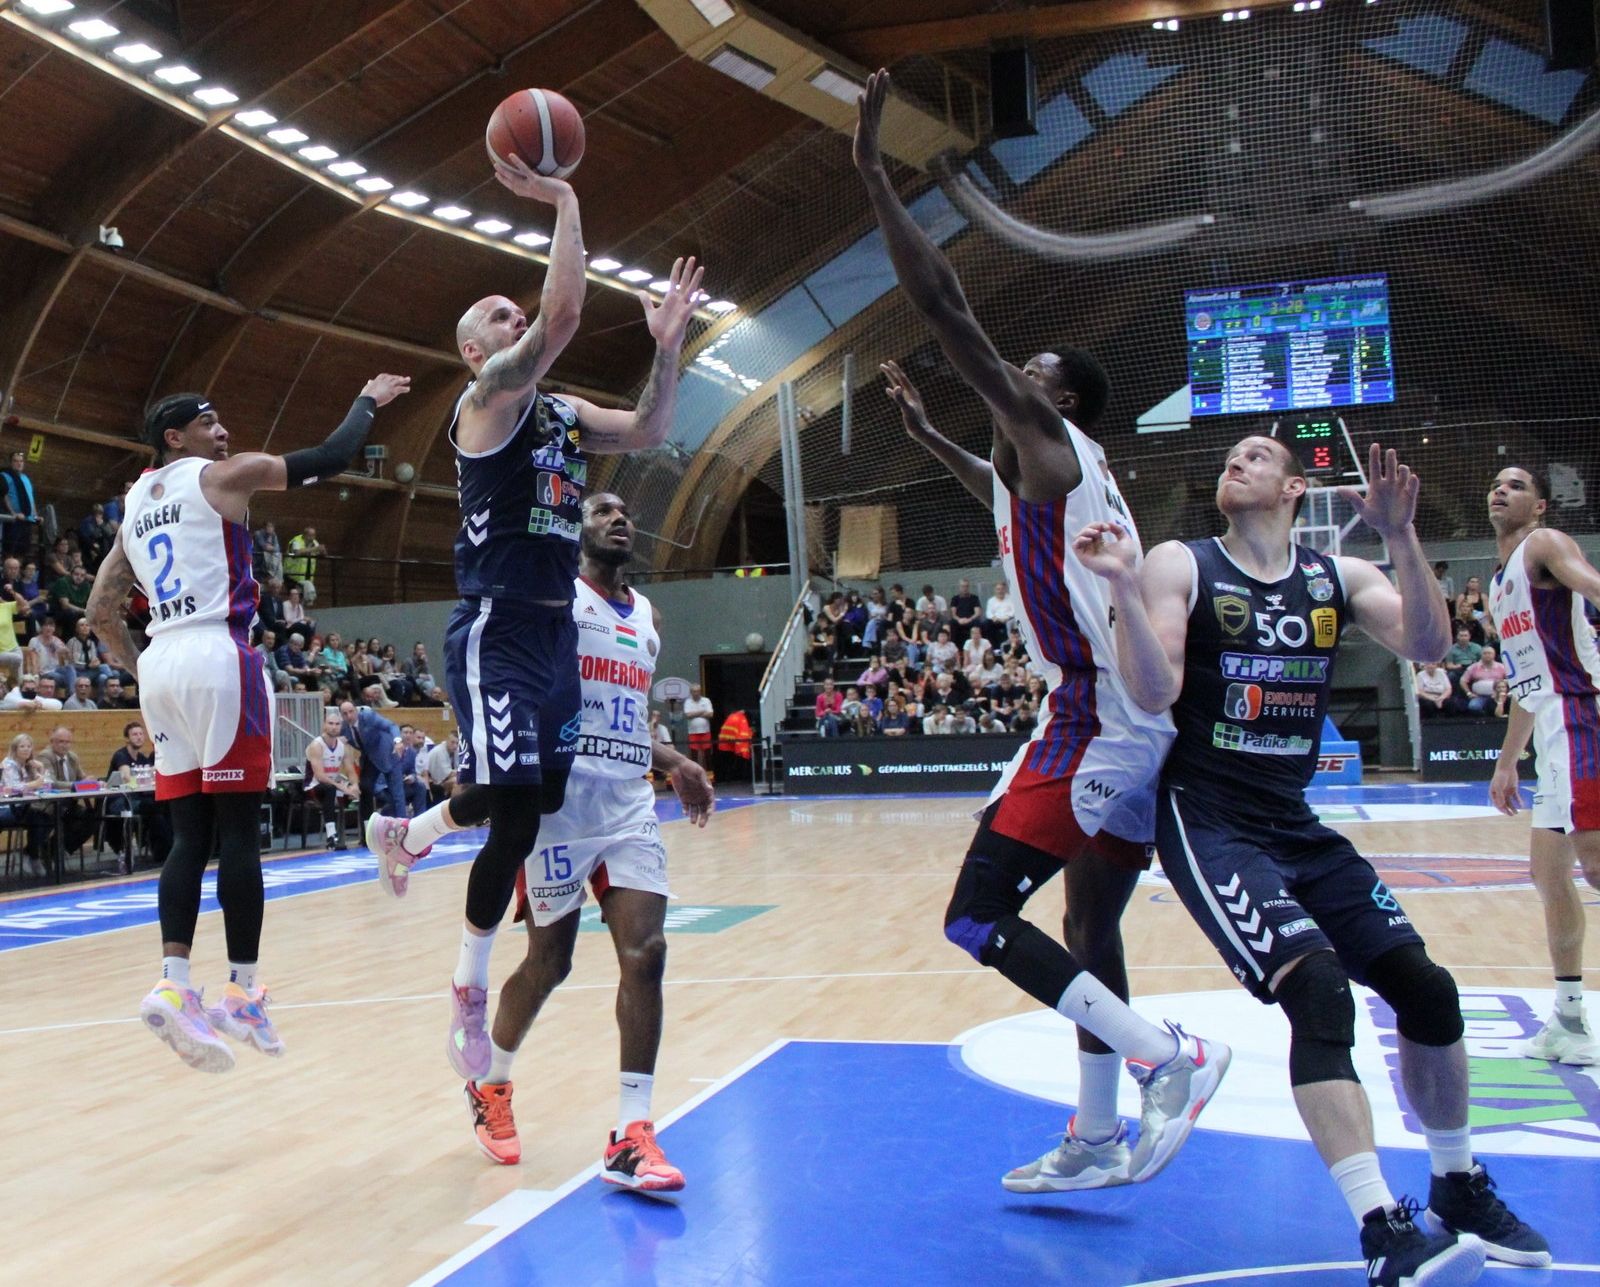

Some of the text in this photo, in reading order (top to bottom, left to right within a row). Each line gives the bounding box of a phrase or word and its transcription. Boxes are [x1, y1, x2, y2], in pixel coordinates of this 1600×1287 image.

[135, 504, 182, 538] GREEN
[148, 532, 182, 603] 2
[1255, 611, 1308, 648] 50
[610, 696, 636, 733] 15
[1263, 706, 1316, 718] SERVICE
[789, 764, 852, 777] MERCARIUS
[878, 763, 922, 775] GÉPJÁRMŰ
[923, 763, 989, 773] FLOTTAKEZELÉS
[540, 845, 572, 881] 15
